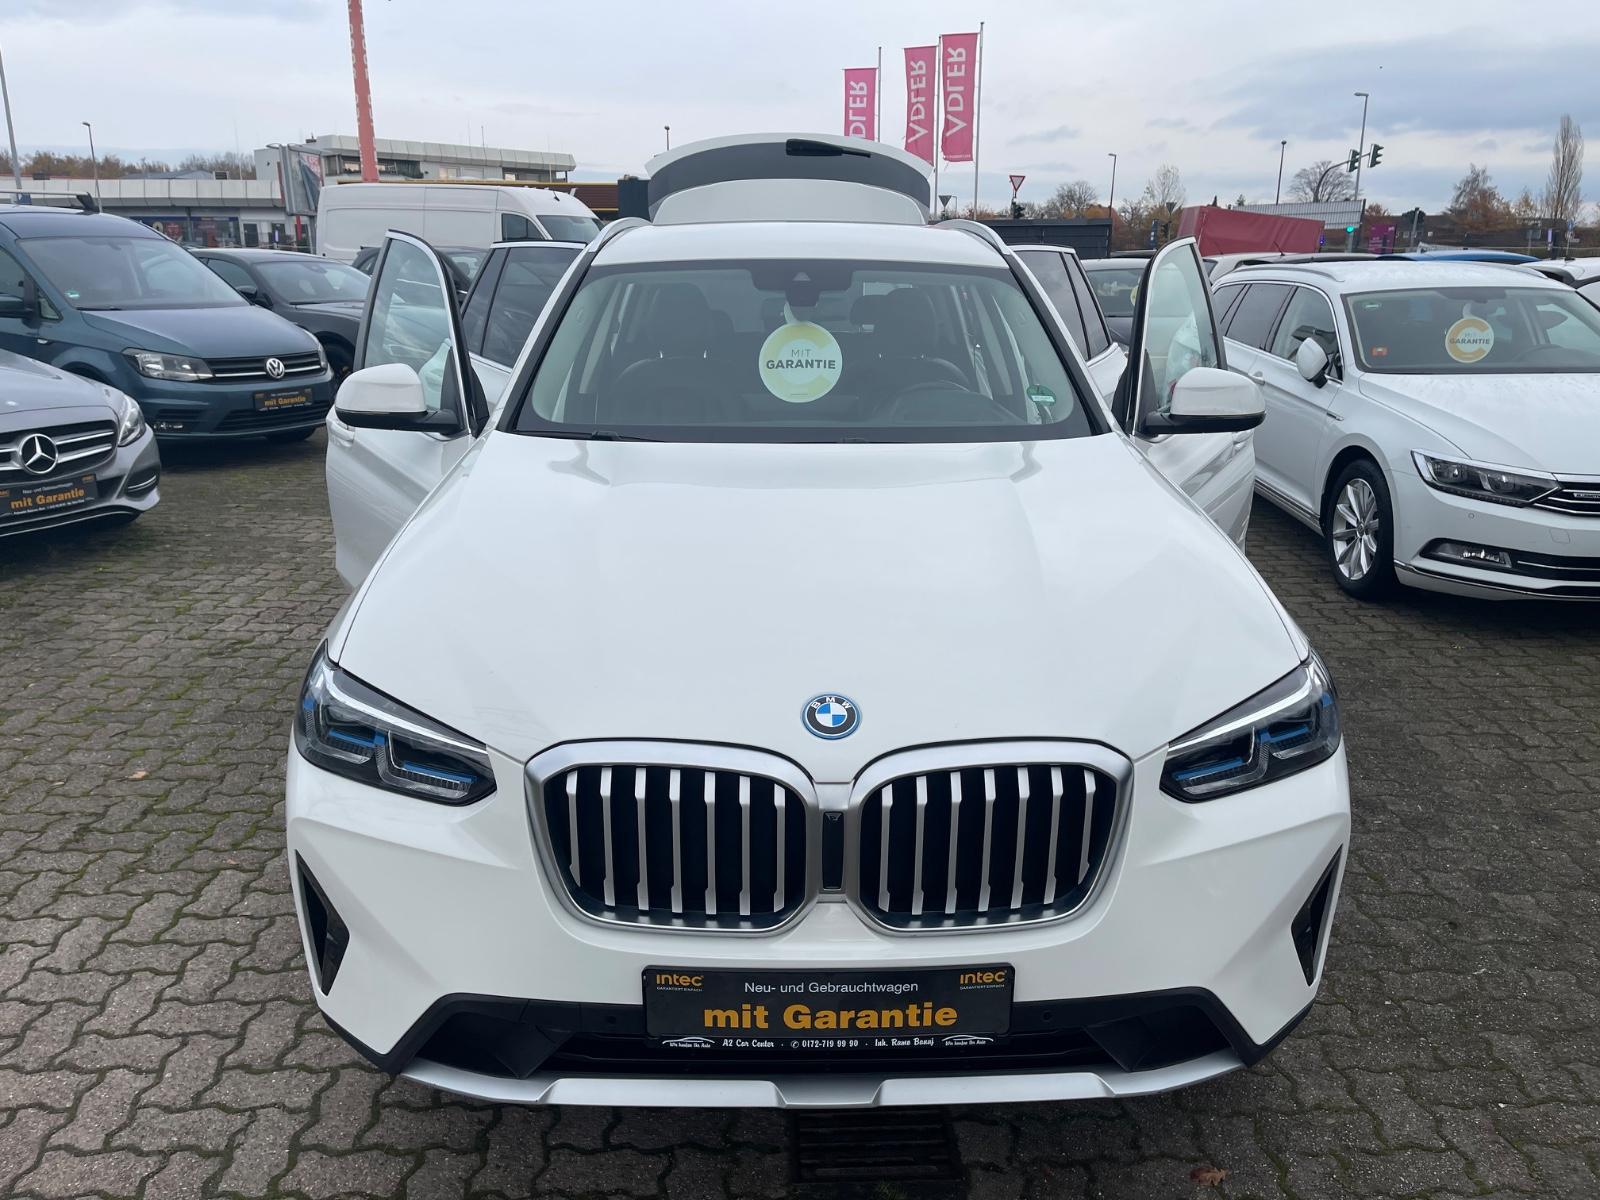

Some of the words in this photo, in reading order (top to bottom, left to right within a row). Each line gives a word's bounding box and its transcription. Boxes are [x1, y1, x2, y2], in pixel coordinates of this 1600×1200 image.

[1450, 337, 1490, 345] GARANTIE
[791, 349, 811, 357] MIT
[766, 359, 836, 369] GARANTIE
[11, 498, 32, 509] mit
[36, 488, 85, 505] Garantie
[810, 696, 851, 709] BMW
[744, 982, 776, 993] Neu-
[780, 982, 804, 993] und
[808, 982, 919, 995] Gebrauchtwagen
[704, 1004, 769, 1029] mit
[783, 1002, 958, 1030] Garantie
[722, 1039, 733, 1047] A2
[736, 1039, 749, 1047] Car
[751, 1039, 774, 1048] Center
[802, 1039, 834, 1048] 0172-719
[837, 1039, 847, 1048] 99
[849, 1039, 859, 1048] 90
